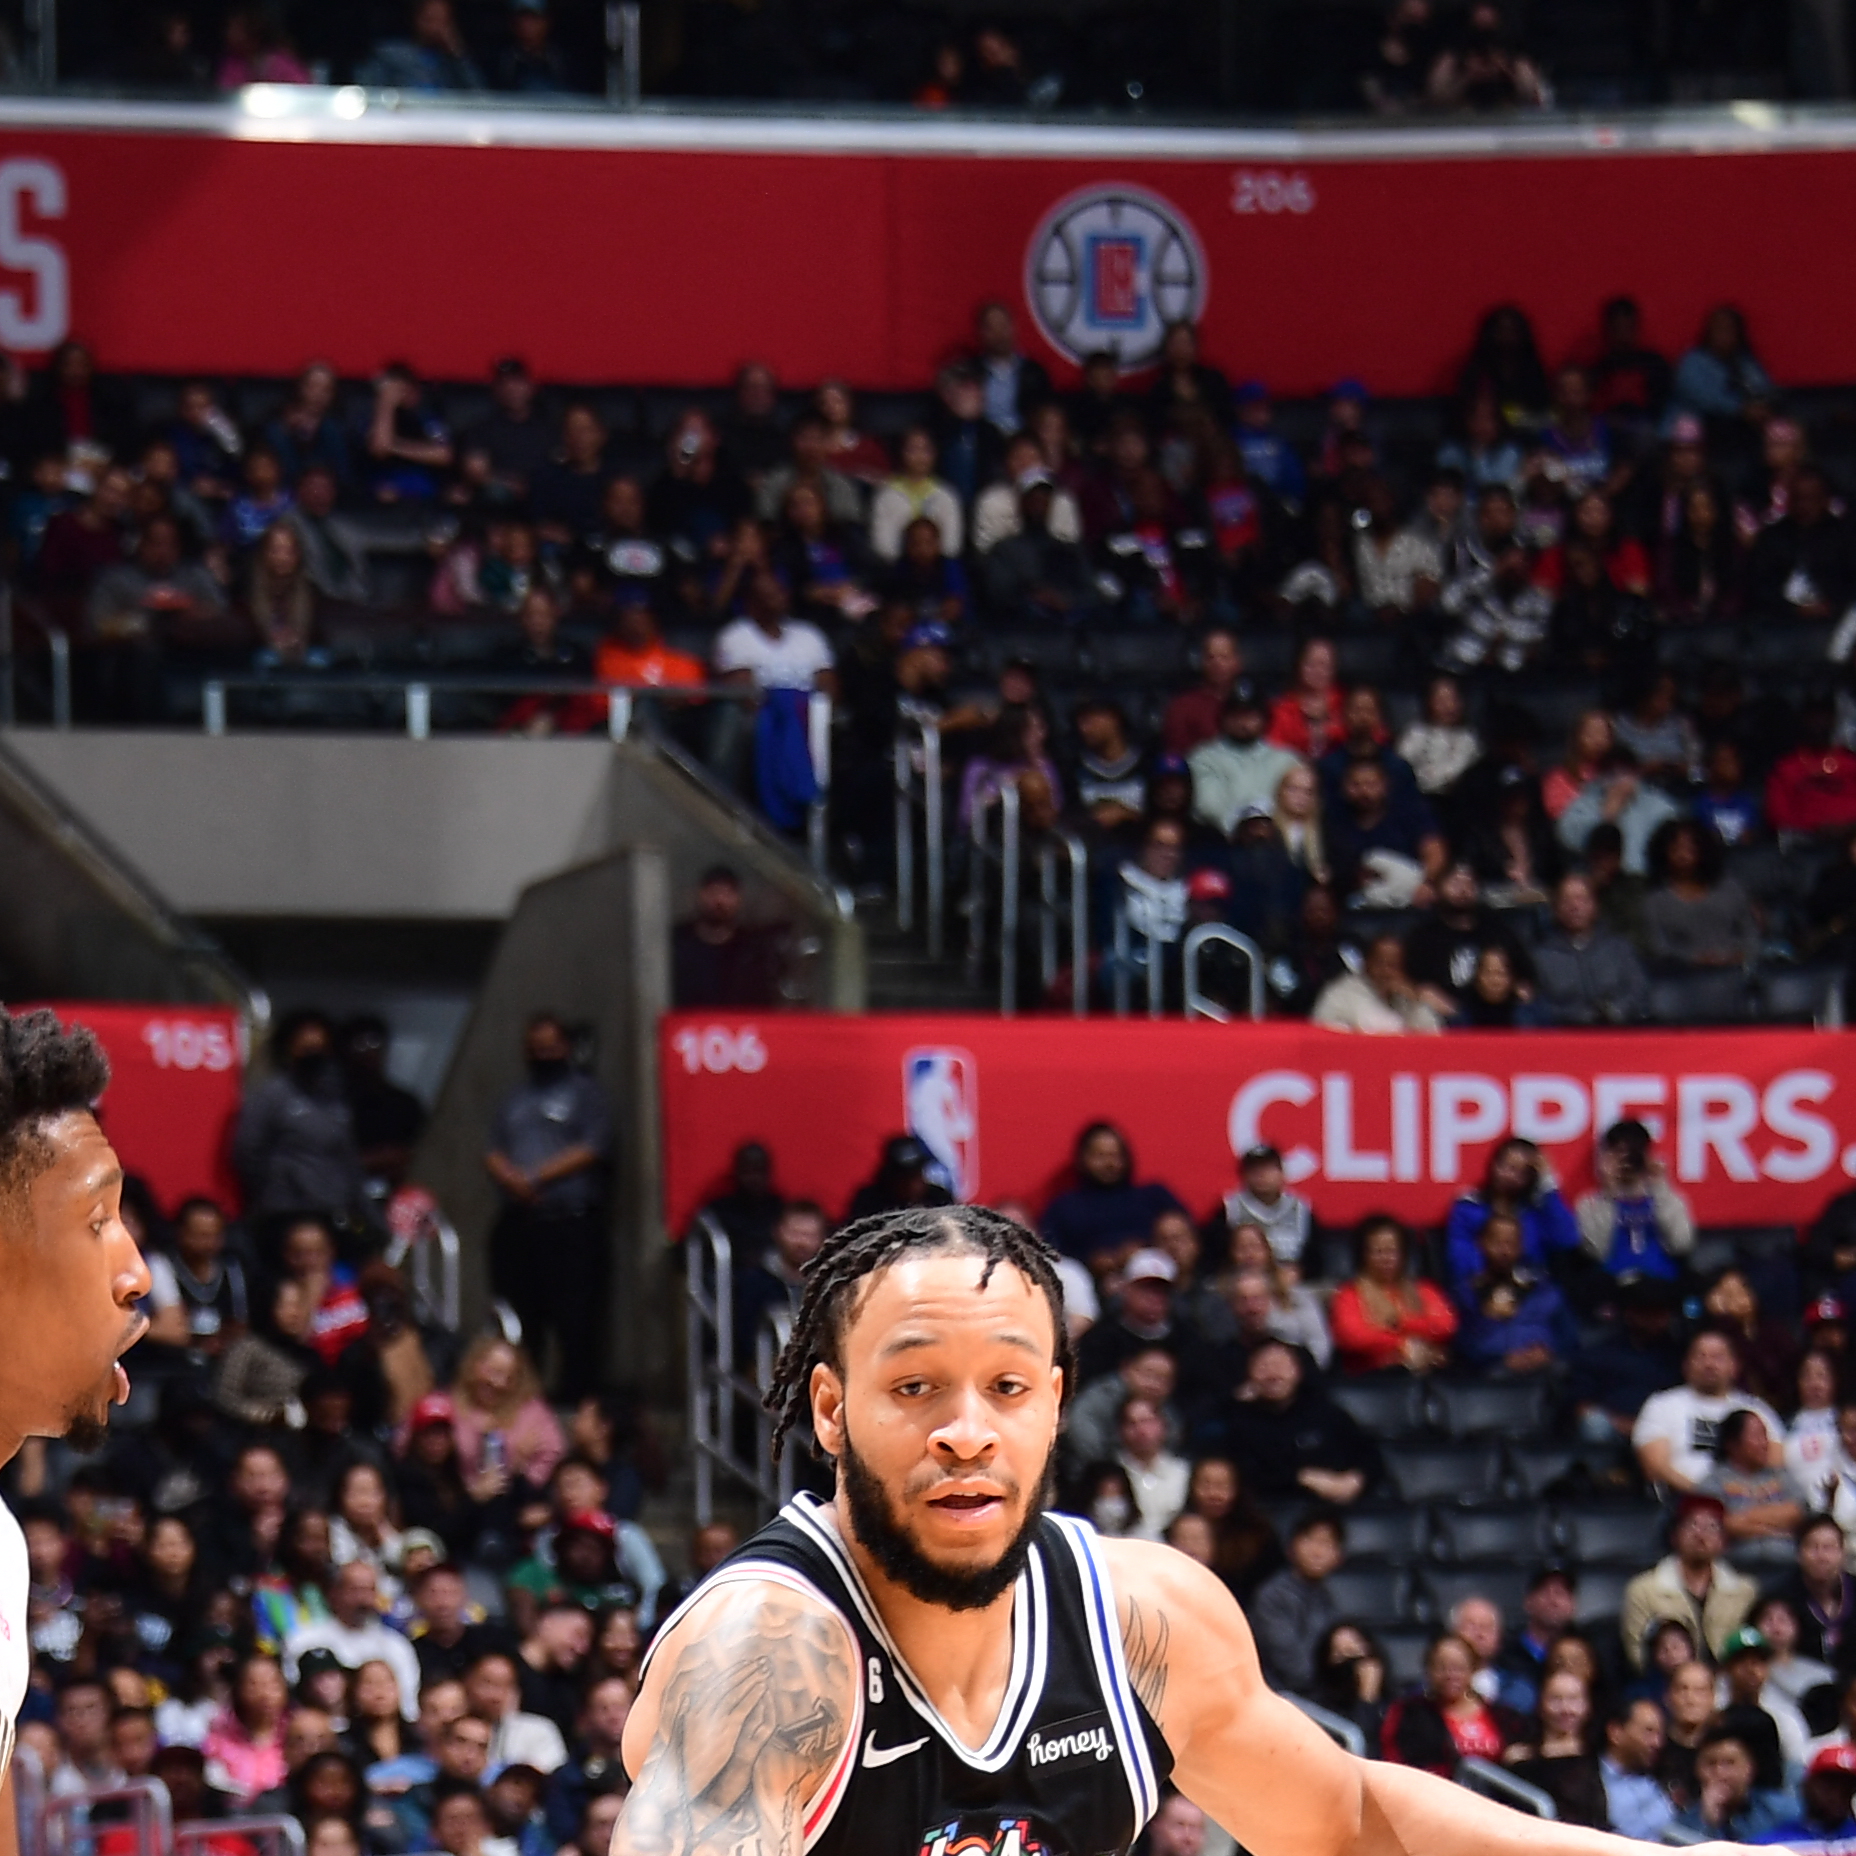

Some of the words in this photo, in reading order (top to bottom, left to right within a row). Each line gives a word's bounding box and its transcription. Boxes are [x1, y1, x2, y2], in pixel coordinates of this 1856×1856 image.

[1231, 171, 1314, 213] 206
[146, 1021, 232, 1072] 105
[674, 1026, 767, 1075] 106
[868, 1657, 884, 1704] 6
[1026, 1726, 1114, 1767] honey
